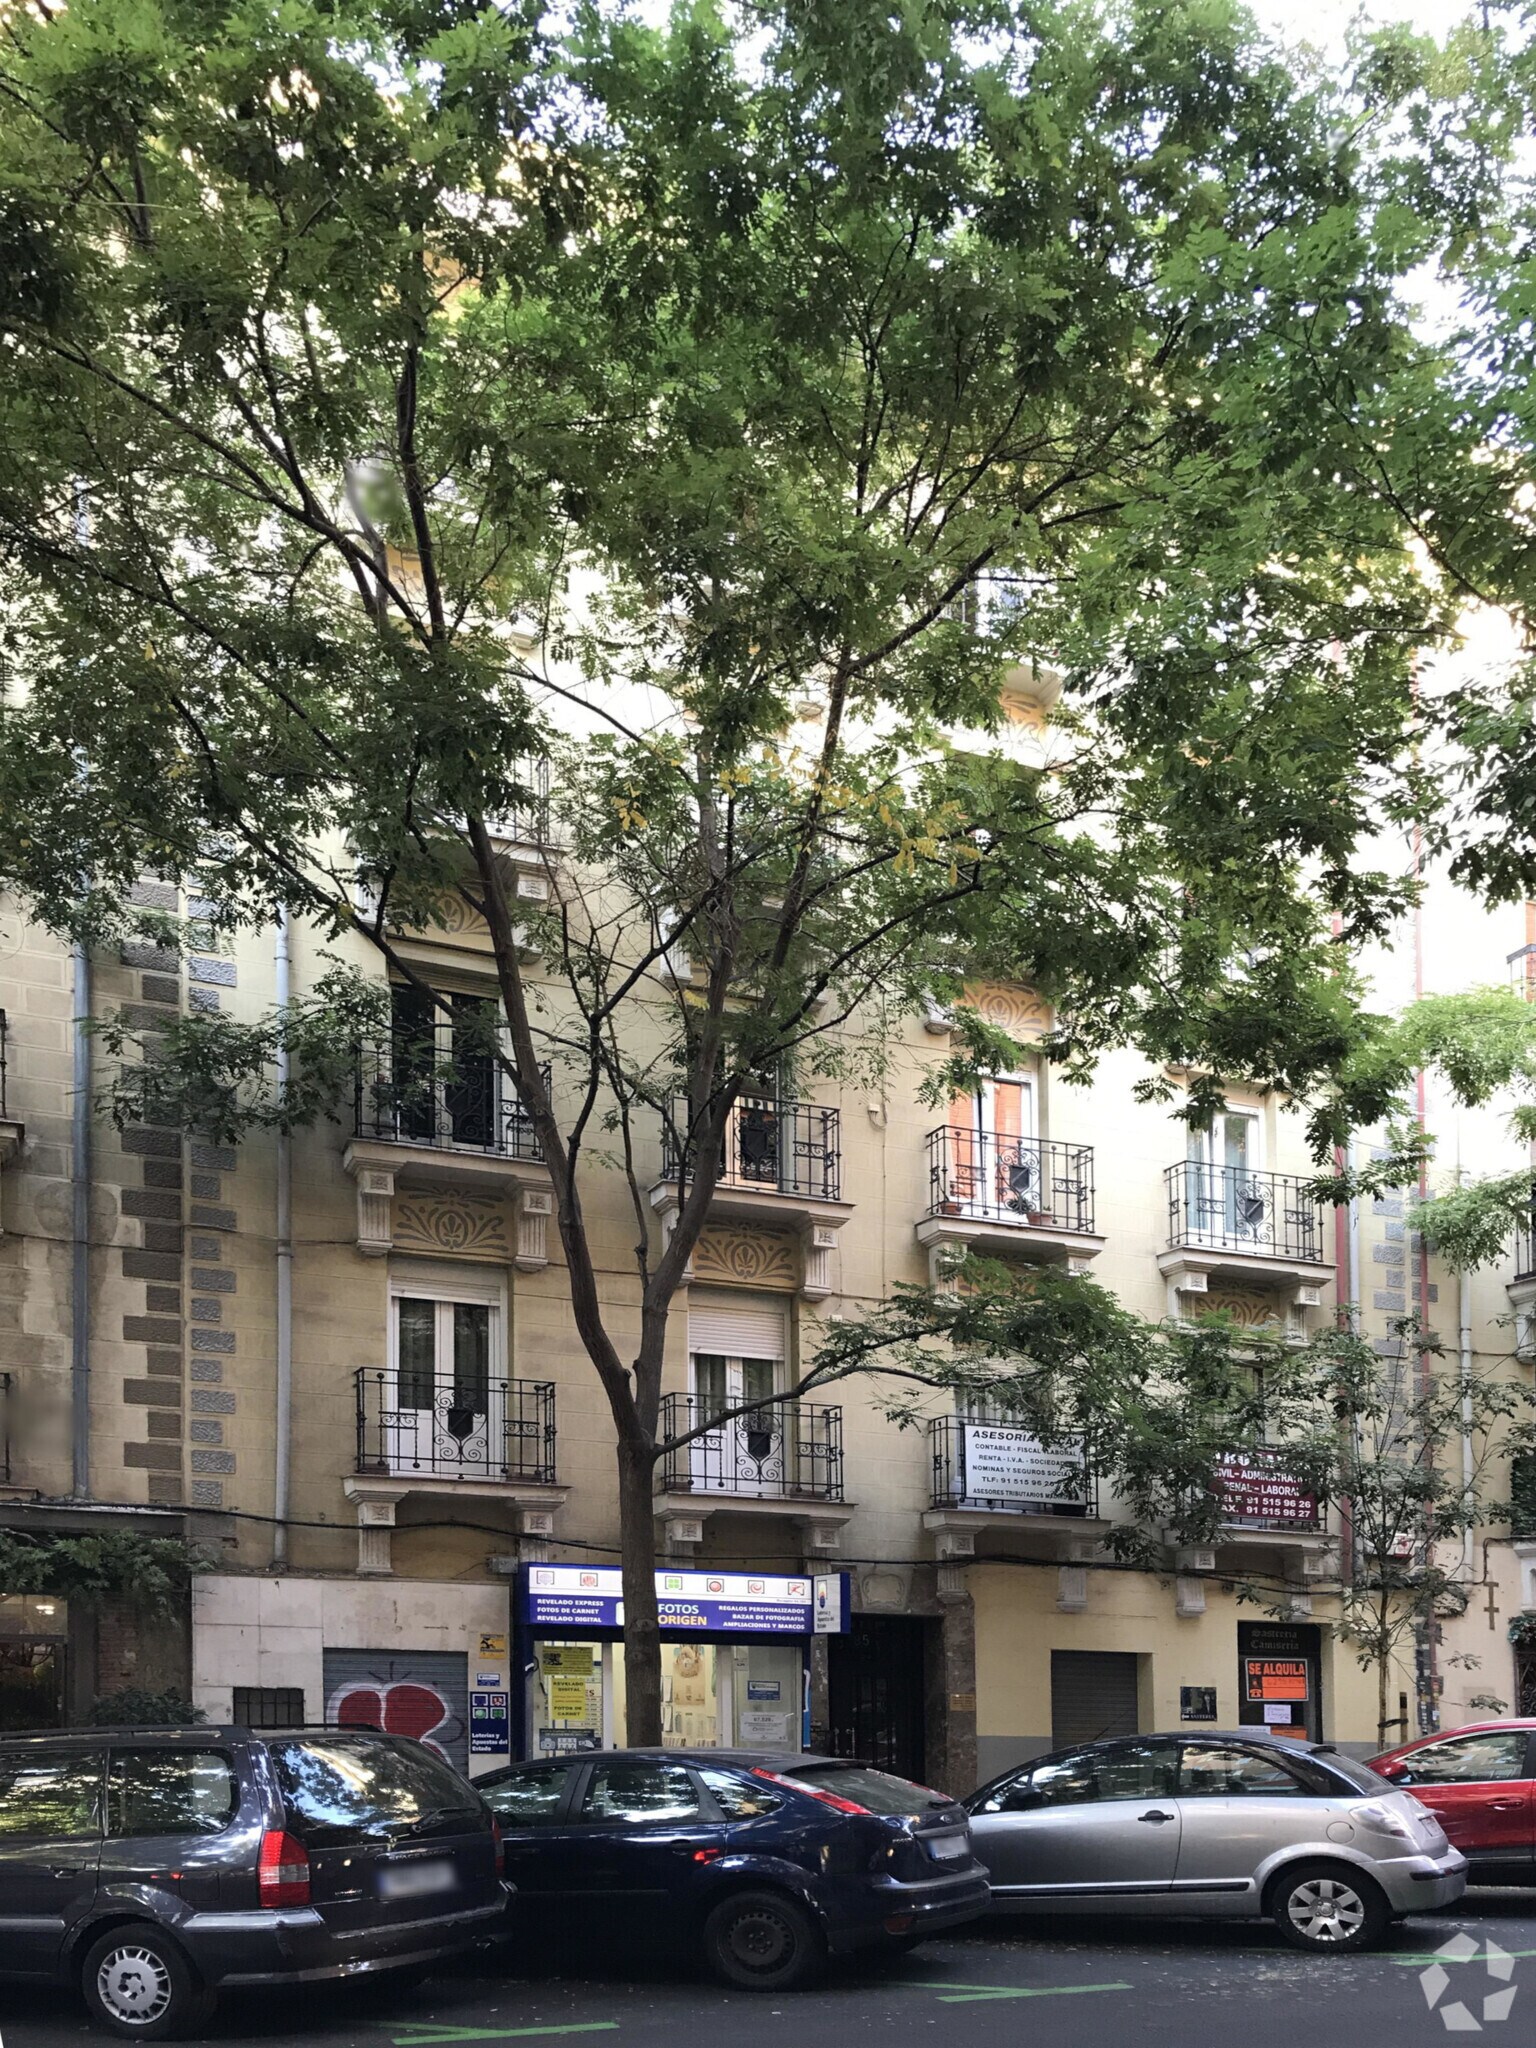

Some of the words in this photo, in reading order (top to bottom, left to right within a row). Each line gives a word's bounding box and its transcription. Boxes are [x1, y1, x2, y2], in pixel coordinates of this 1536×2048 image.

[974, 1444, 1012, 1452] CONTABLE
[978, 1454, 1002, 1462] RENTA
[1012, 1468, 1046, 1476] SEGUROS
[1006, 1490, 1044, 1498] TRIBUTARIOS
[1246, 1496, 1258, 1504] 91
[1262, 1498, 1280, 1506] 515
[1298, 1500, 1311, 1508] 26
[1217, 1504, 1239, 1513] AX.
[1246, 1506, 1258, 1514] 91
[1262, 1507, 1280, 1516] 515
[1283, 1508, 1296, 1516] 96
[1298, 1510, 1311, 1518] 27
[537, 1598, 573, 1606] REVELADO
[658, 1604, 699, 1614] FOTOS
[748, 1606, 804, 1614] PERSONALIZADOS
[658, 1614, 708, 1626] ORIGEN
[766, 1614, 804, 1622] FOTOGRAFIA
[1248, 1662, 1261, 1675] SE
[1263, 1663, 1305, 1676] ALQUILA
